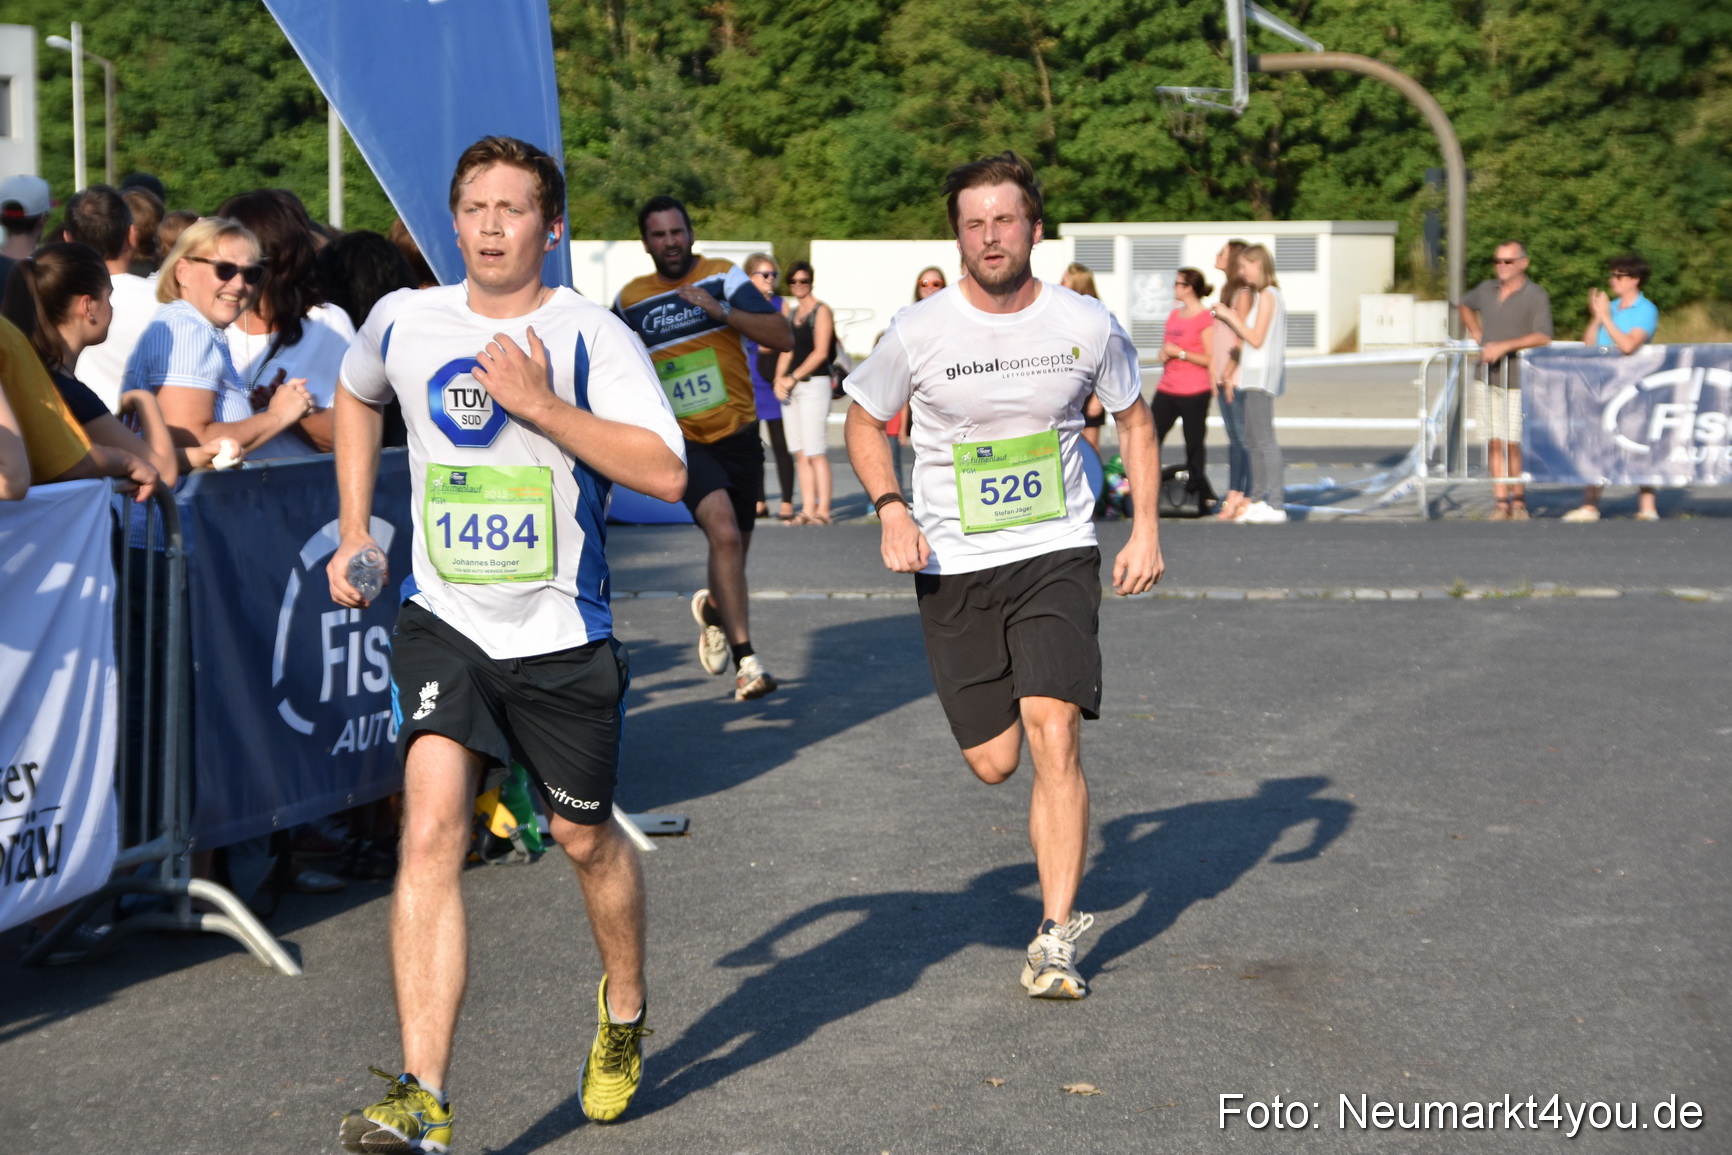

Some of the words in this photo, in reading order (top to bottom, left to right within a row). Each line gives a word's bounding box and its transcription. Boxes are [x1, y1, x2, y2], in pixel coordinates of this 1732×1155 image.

[946, 353, 1074, 380] globalconcepts
[448, 388, 489, 408] TÜV
[672, 374, 711, 399] 415
[461, 414, 482, 425] SÜD
[1646, 403, 1732, 442] Fis
[980, 470, 1042, 505] 526
[994, 509, 1014, 517] Stefan
[1015, 506, 1032, 516] Jäger
[436, 512, 539, 551] 1484
[452, 558, 488, 566] Johannes
[490, 559, 519, 567] Bogner
[0, 762, 38, 805] er
[0, 810, 62, 887] räu
